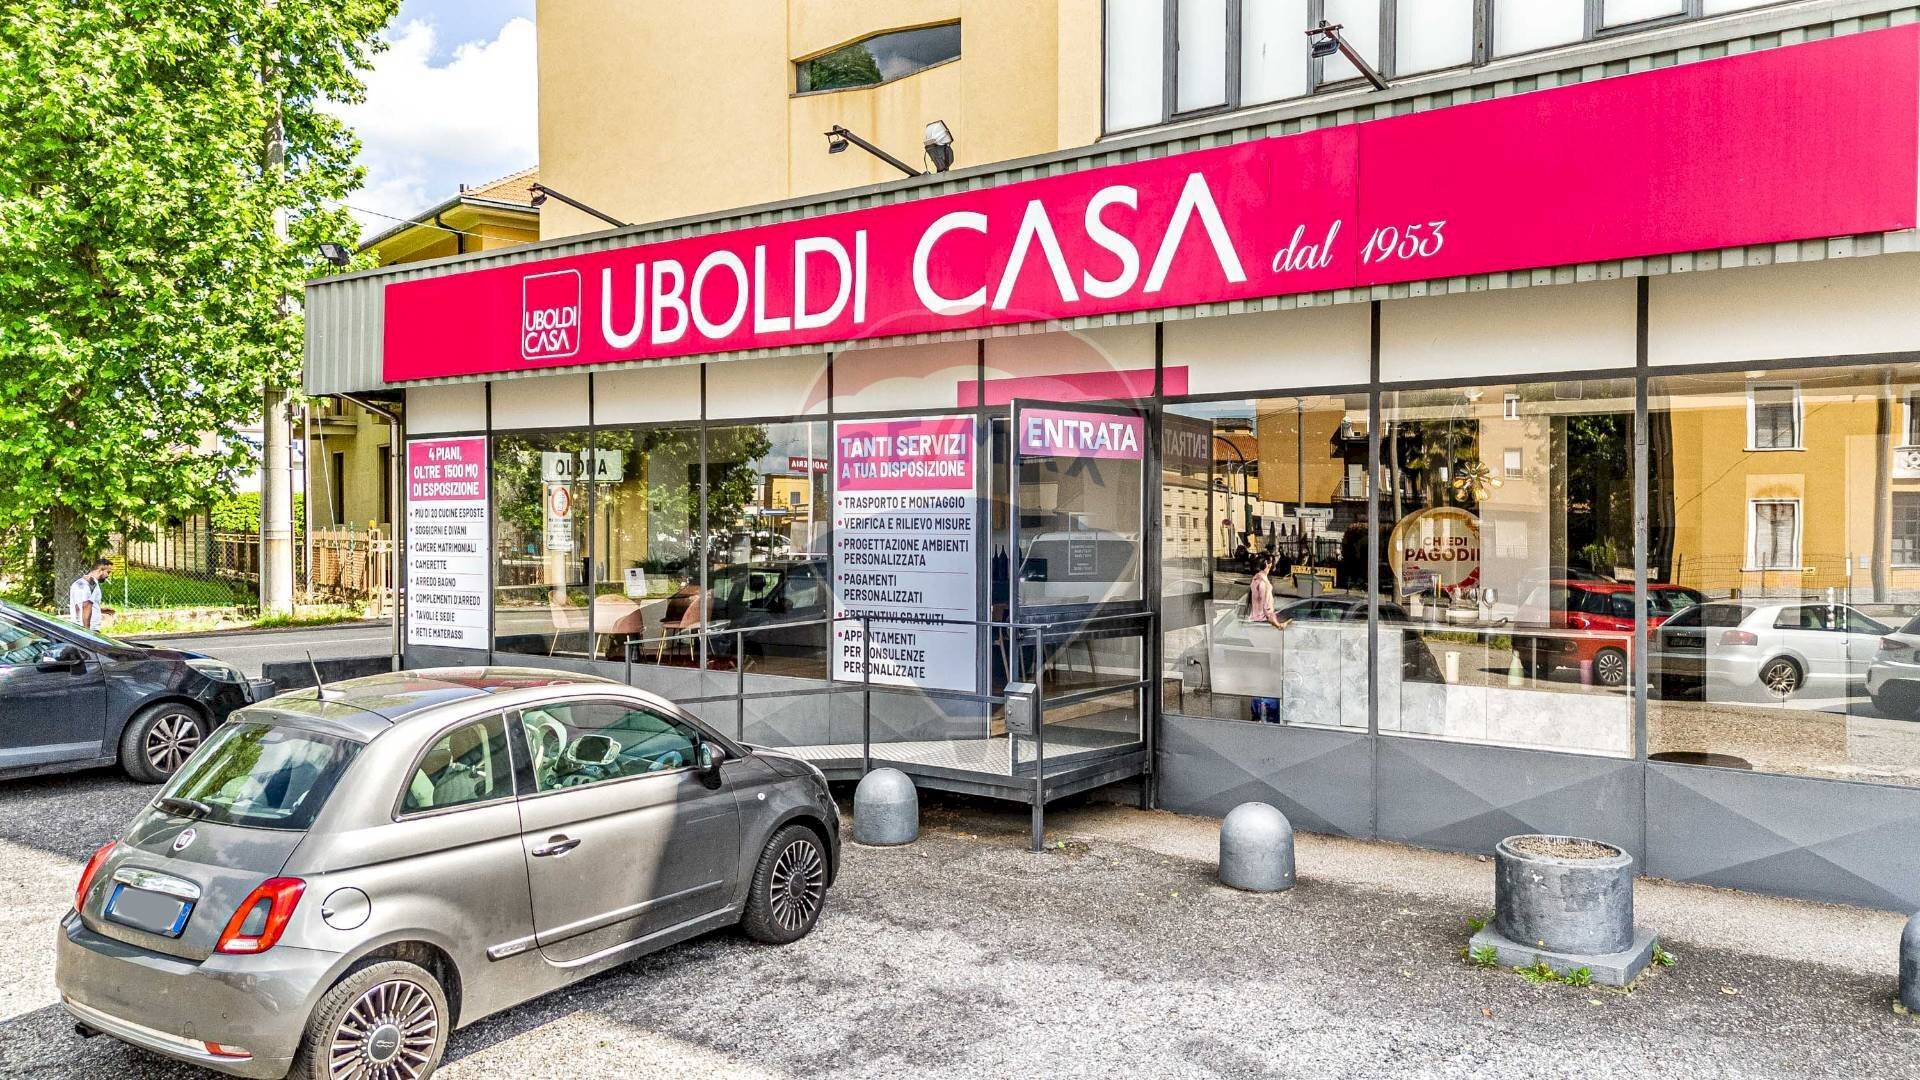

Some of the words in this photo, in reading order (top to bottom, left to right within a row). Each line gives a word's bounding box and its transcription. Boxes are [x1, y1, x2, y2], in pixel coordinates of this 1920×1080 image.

[602, 229, 867, 349] UBOLDI
[913, 172, 1247, 316] CASA
[1272, 219, 1342, 272] dal
[1360, 220, 1446, 265] 1953
[526, 306, 577, 332] UBOLDI
[525, 328, 570, 353] CASA
[1028, 416, 1138, 452] ENTRATA
[841, 436, 893, 458] TANTI
[896, 434, 966, 456] SERVIZI
[428, 448, 435, 461] 4
[436, 446, 463, 461] PIANI,
[414, 465, 441, 479] OLTRE
[444, 464, 464, 479] 1500
[465, 464, 479, 479] MQ
[842, 463, 850, 479] A
[853, 462, 878, 479] TUA
[880, 460, 966, 478] DISPOSIZIONE
[414, 483, 422, 497] DI
[423, 481, 480, 497] ESPOSIZIONE
[844, 497, 899, 509] TRASPORTO
[901, 497, 906, 508] E
[909, 496, 965, 509] MONTAGGIO
[431, 508, 438, 518] 20
[439, 508, 458, 518] CUCINE
[459, 508, 484, 518] ESPOSTE
[415, 526, 444, 535] SOGGIORNI
[444, 526, 448, 535] E
[449, 526, 467, 535] DIVANI
[844, 518, 886, 530] VERIFICA
[888, 518, 893, 530] E
[896, 518, 932, 530] RILIEVO
[935, 518, 971, 530] MISURE
[415, 542, 437, 552] CAMERE
[438, 543, 477, 553] MATRIMONIALI
[844, 539, 919, 551] PROGETTAZIONE
[922, 539, 969, 552] AMBIENTI
[1423, 537, 1468, 546] CHEDI
[415, 560, 447, 570] CAMERETTE
[844, 553, 926, 566] PERSONALIZZATA
[416, 577, 437, 587] ARREDO
[438, 577, 456, 587] BAGNO
[844, 574, 897, 586] PAGAMENTI
[416, 594, 453, 605] COMPLEMENTI
[454, 595, 481, 606] D'ARREDO
[844, 589, 923, 603] PERSONALIZZATI
[416, 610, 435, 621] TAVOLI
[436, 611, 439, 621] E
[440, 612, 455, 622] SEDIE
[844, 610, 898, 623] PREVENTIVI
[900, 613, 944, 626] GRATUITI
[416, 628, 428, 638] RETI
[429, 628, 432, 638] E
[433, 629, 464, 640] MATERASSI
[844, 630, 916, 646] APPNTAMENTI
[844, 646, 861, 658] PER
[866, 647, 925, 662] ONSULENZE
